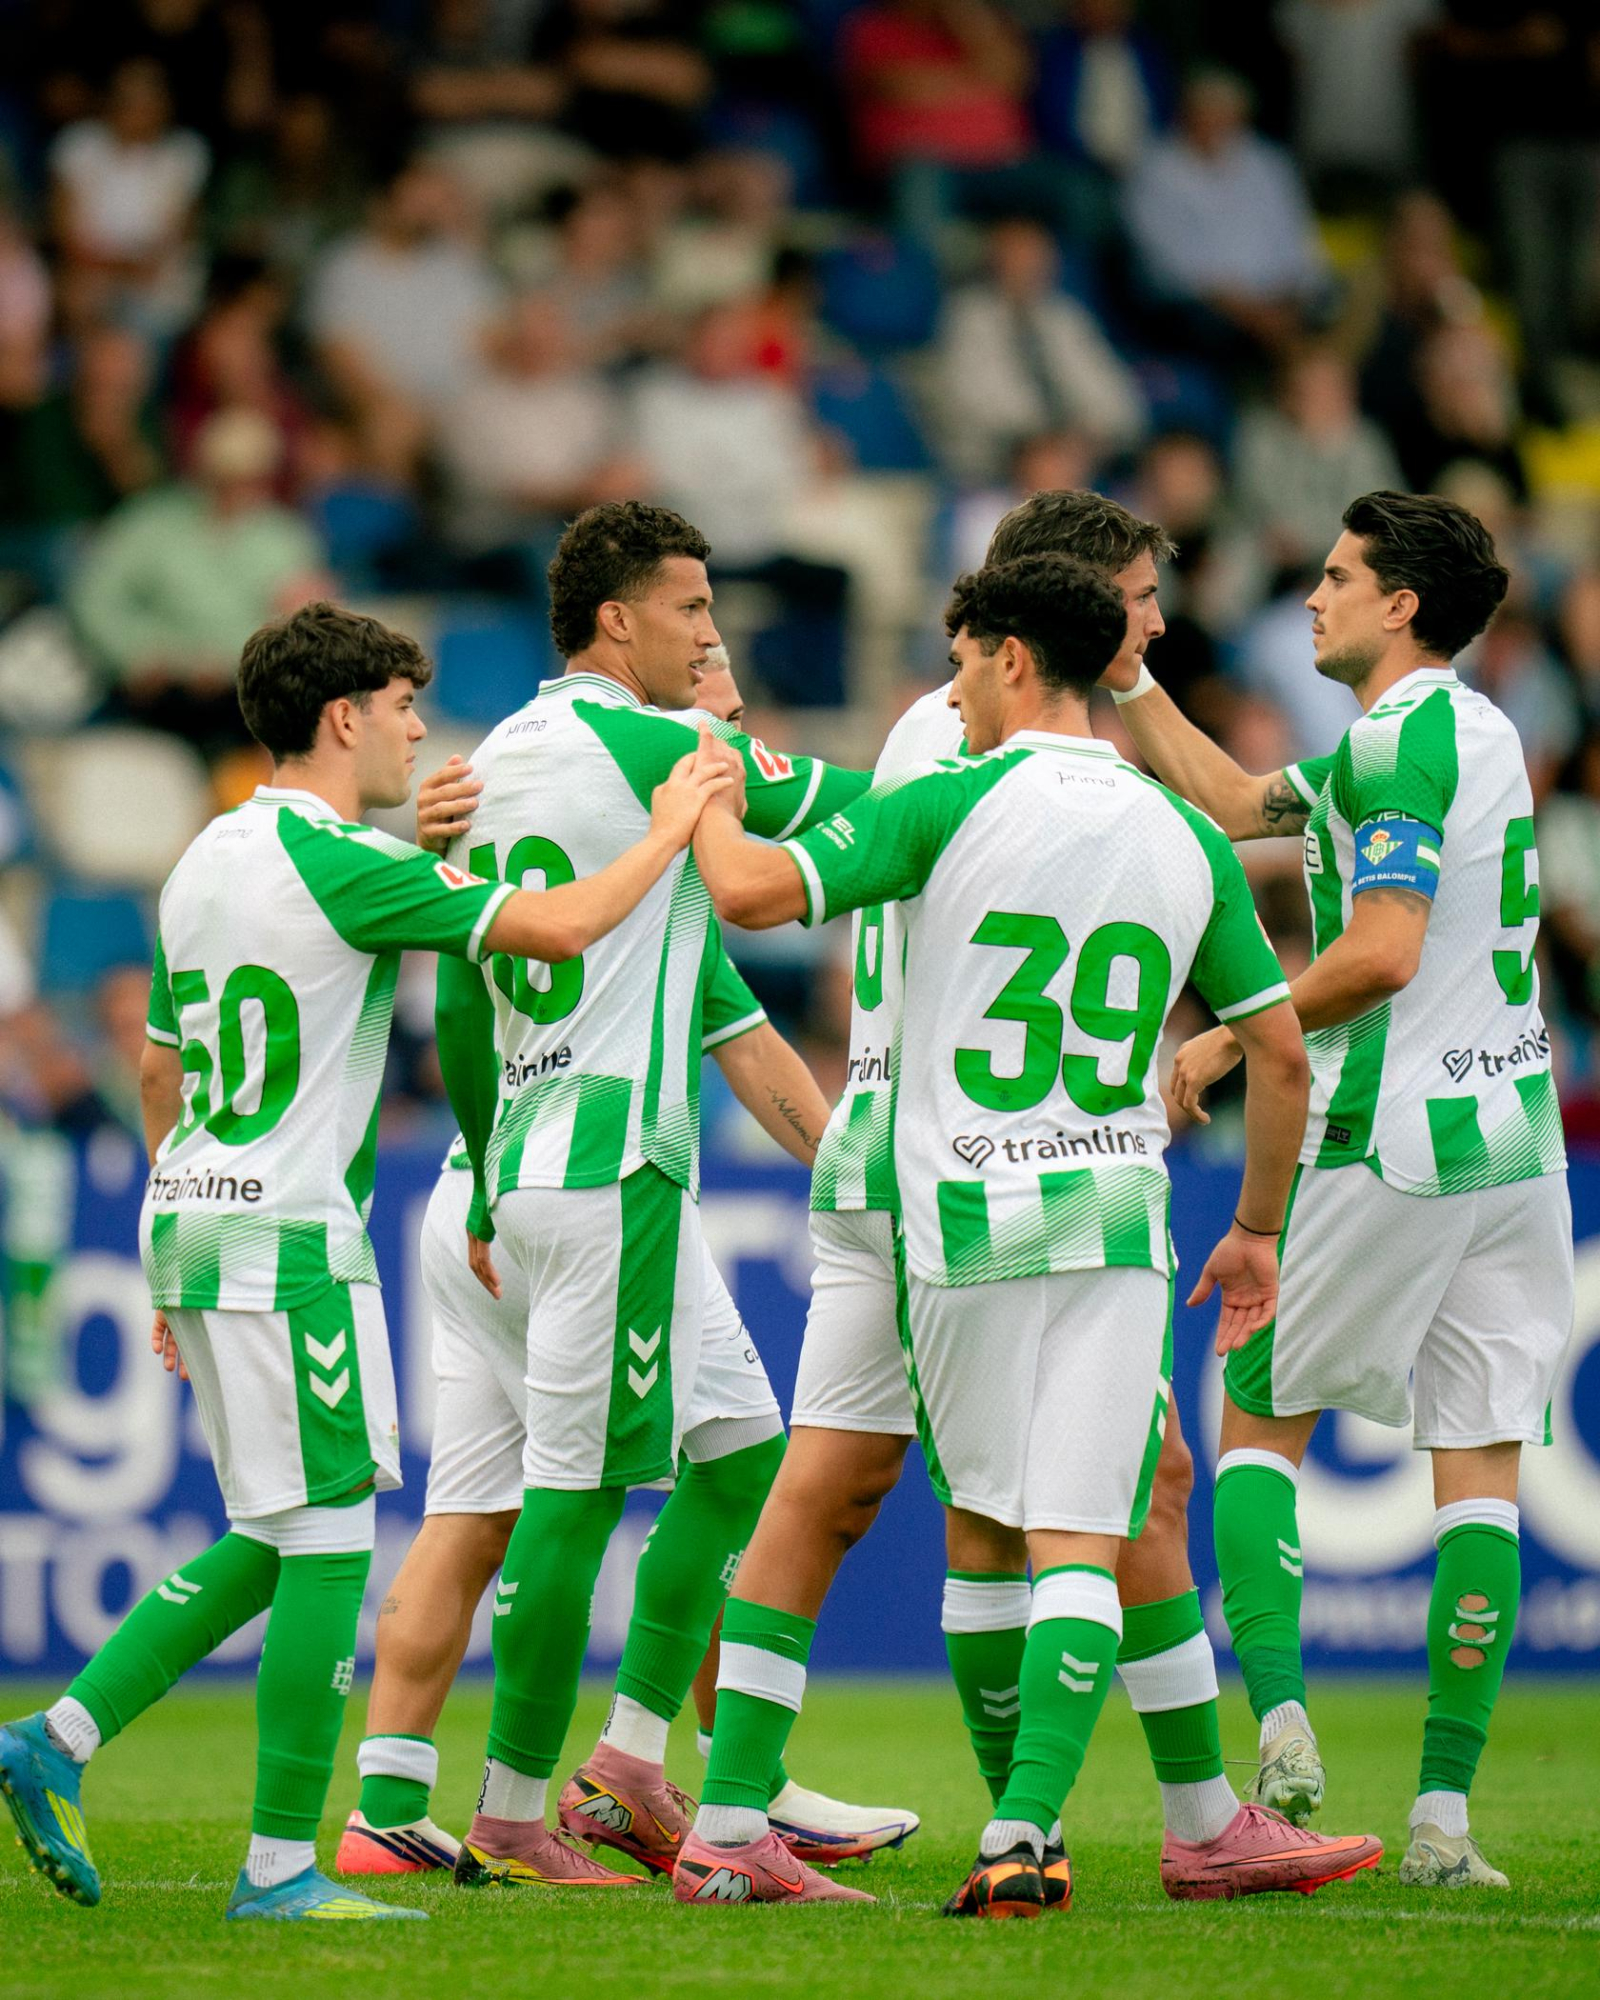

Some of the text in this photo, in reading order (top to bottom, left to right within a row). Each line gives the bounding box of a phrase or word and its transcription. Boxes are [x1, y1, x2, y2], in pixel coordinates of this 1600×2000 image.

[168, 964, 301, 1155] 50
[954, 910, 1172, 1117] 39
[152, 1168, 263, 1202] trainline
[1001, 1125, 1148, 1163] trainline
